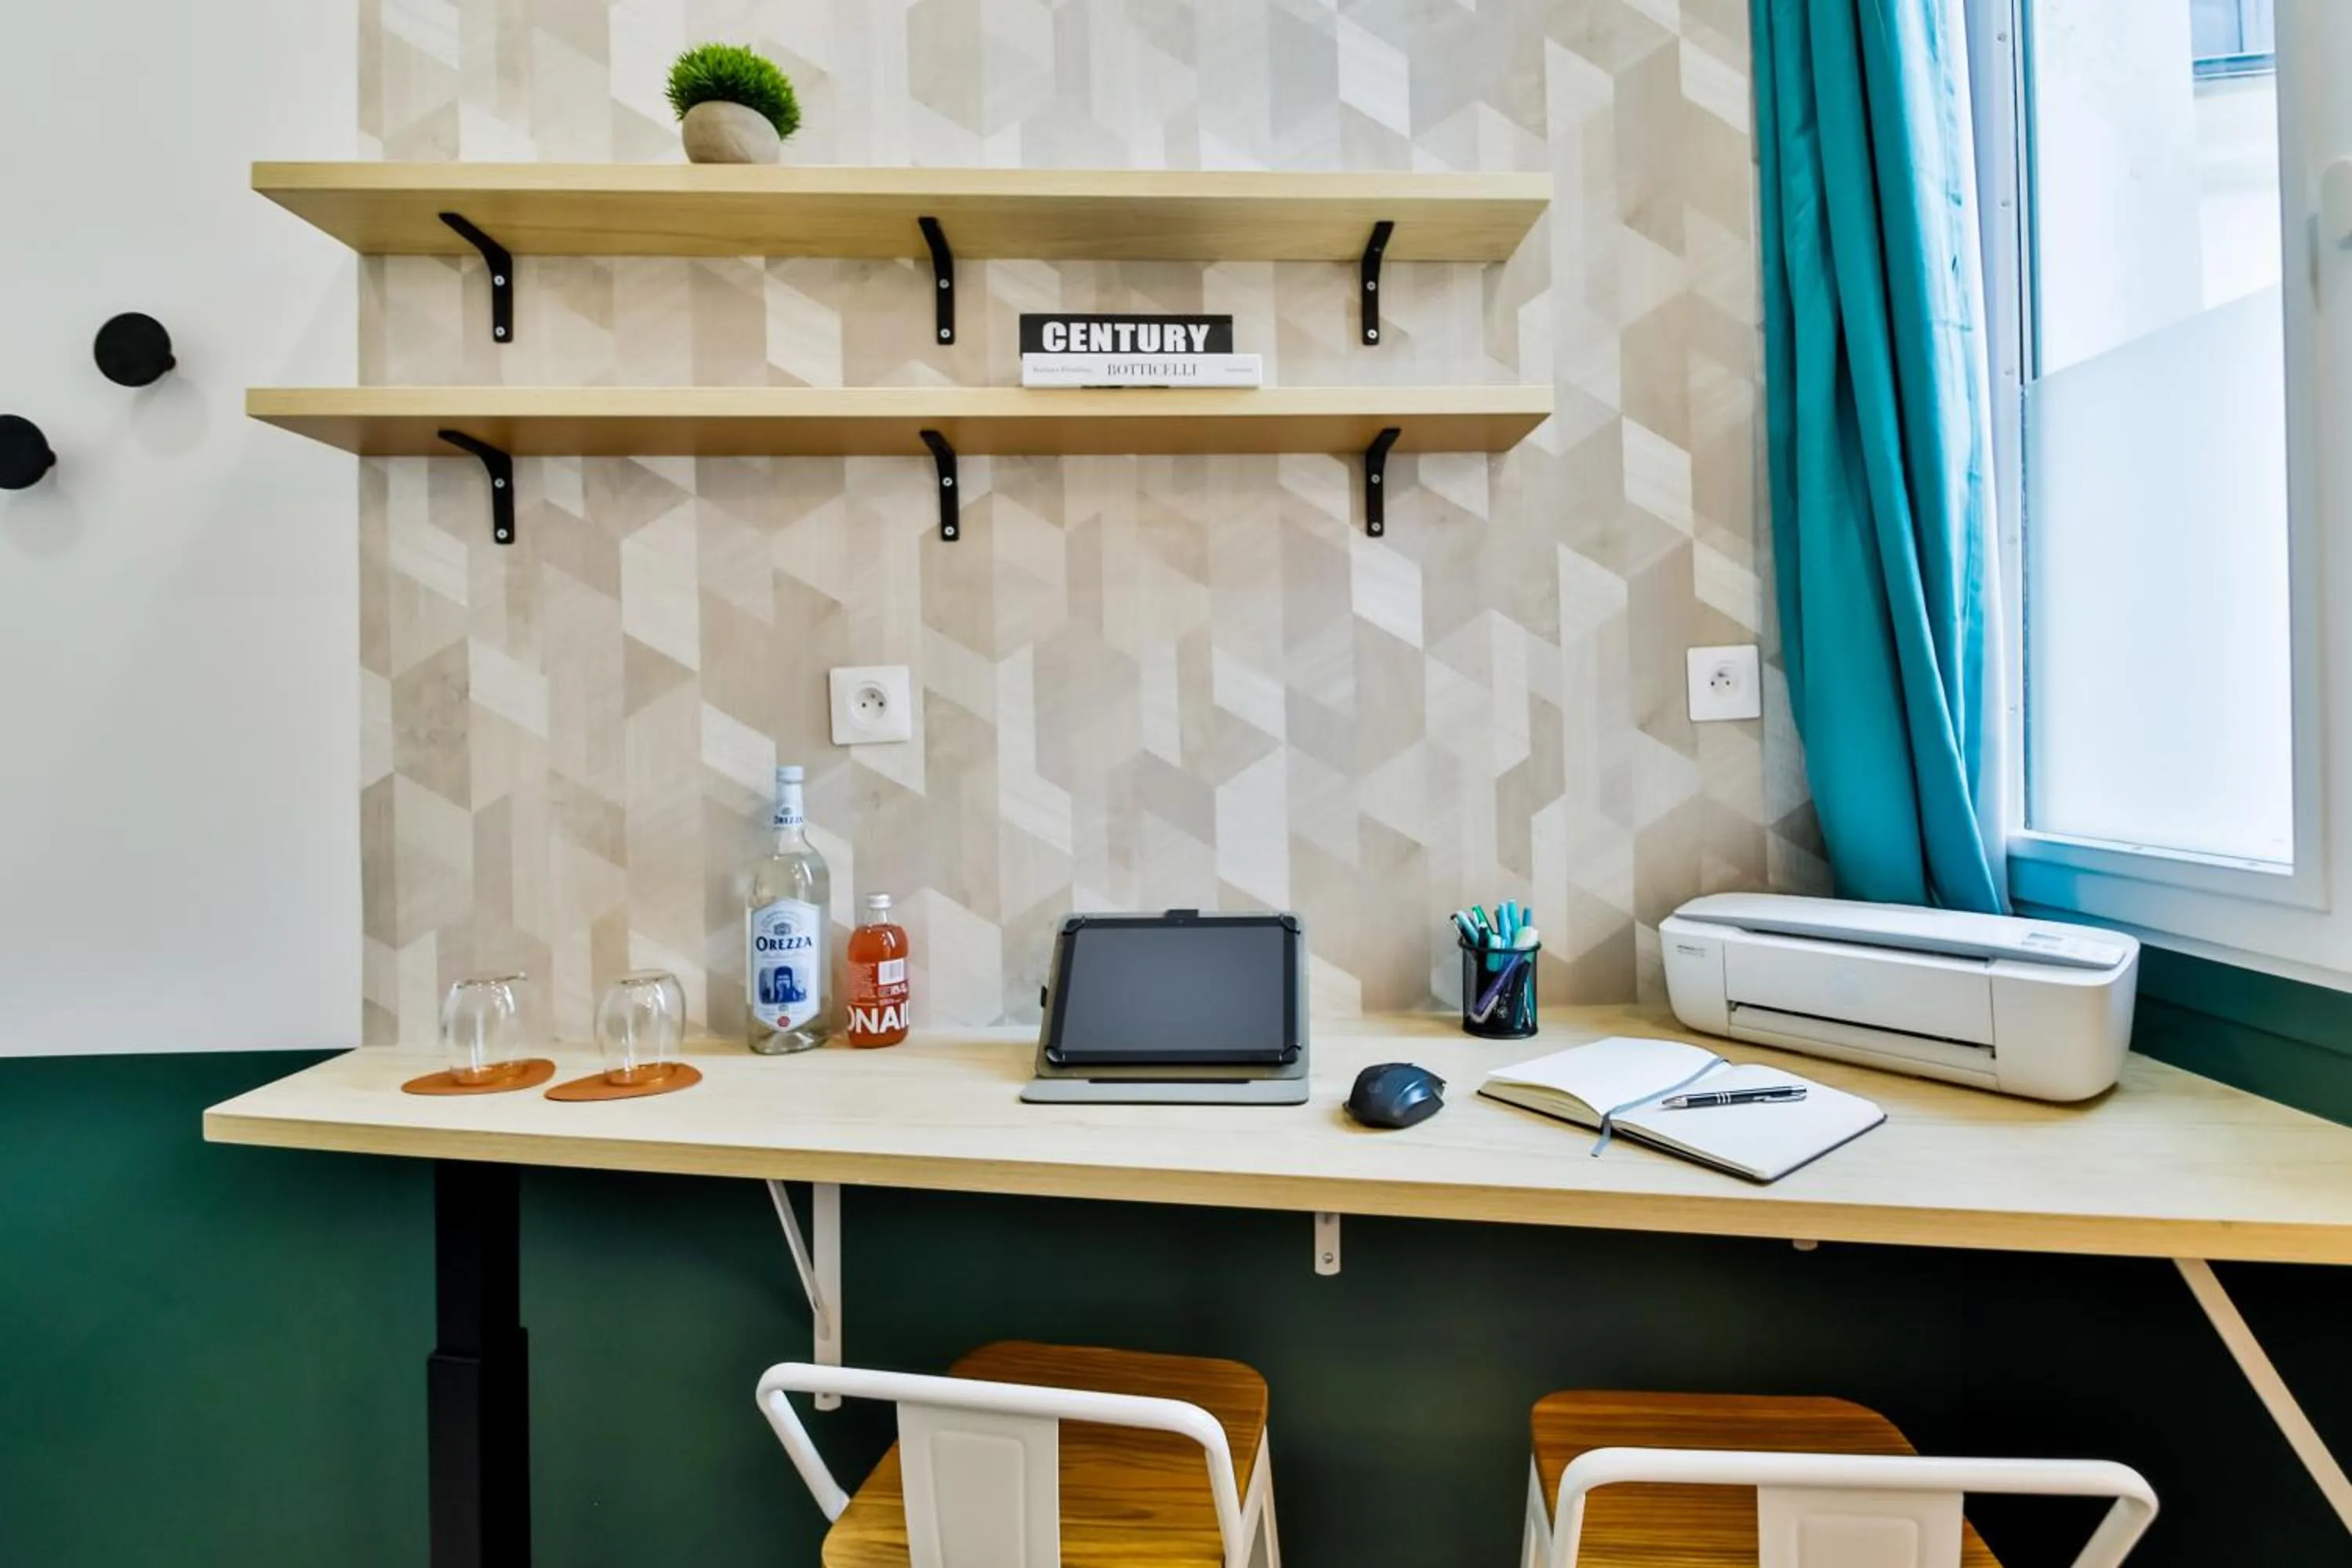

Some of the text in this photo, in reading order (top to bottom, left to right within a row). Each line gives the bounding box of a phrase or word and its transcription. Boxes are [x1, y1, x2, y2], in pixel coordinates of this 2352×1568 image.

[1042, 321, 1210, 352] CENTURY
[1107, 363, 1196, 376] BOTTICELLI
[756, 936, 812, 952] OREZZA
